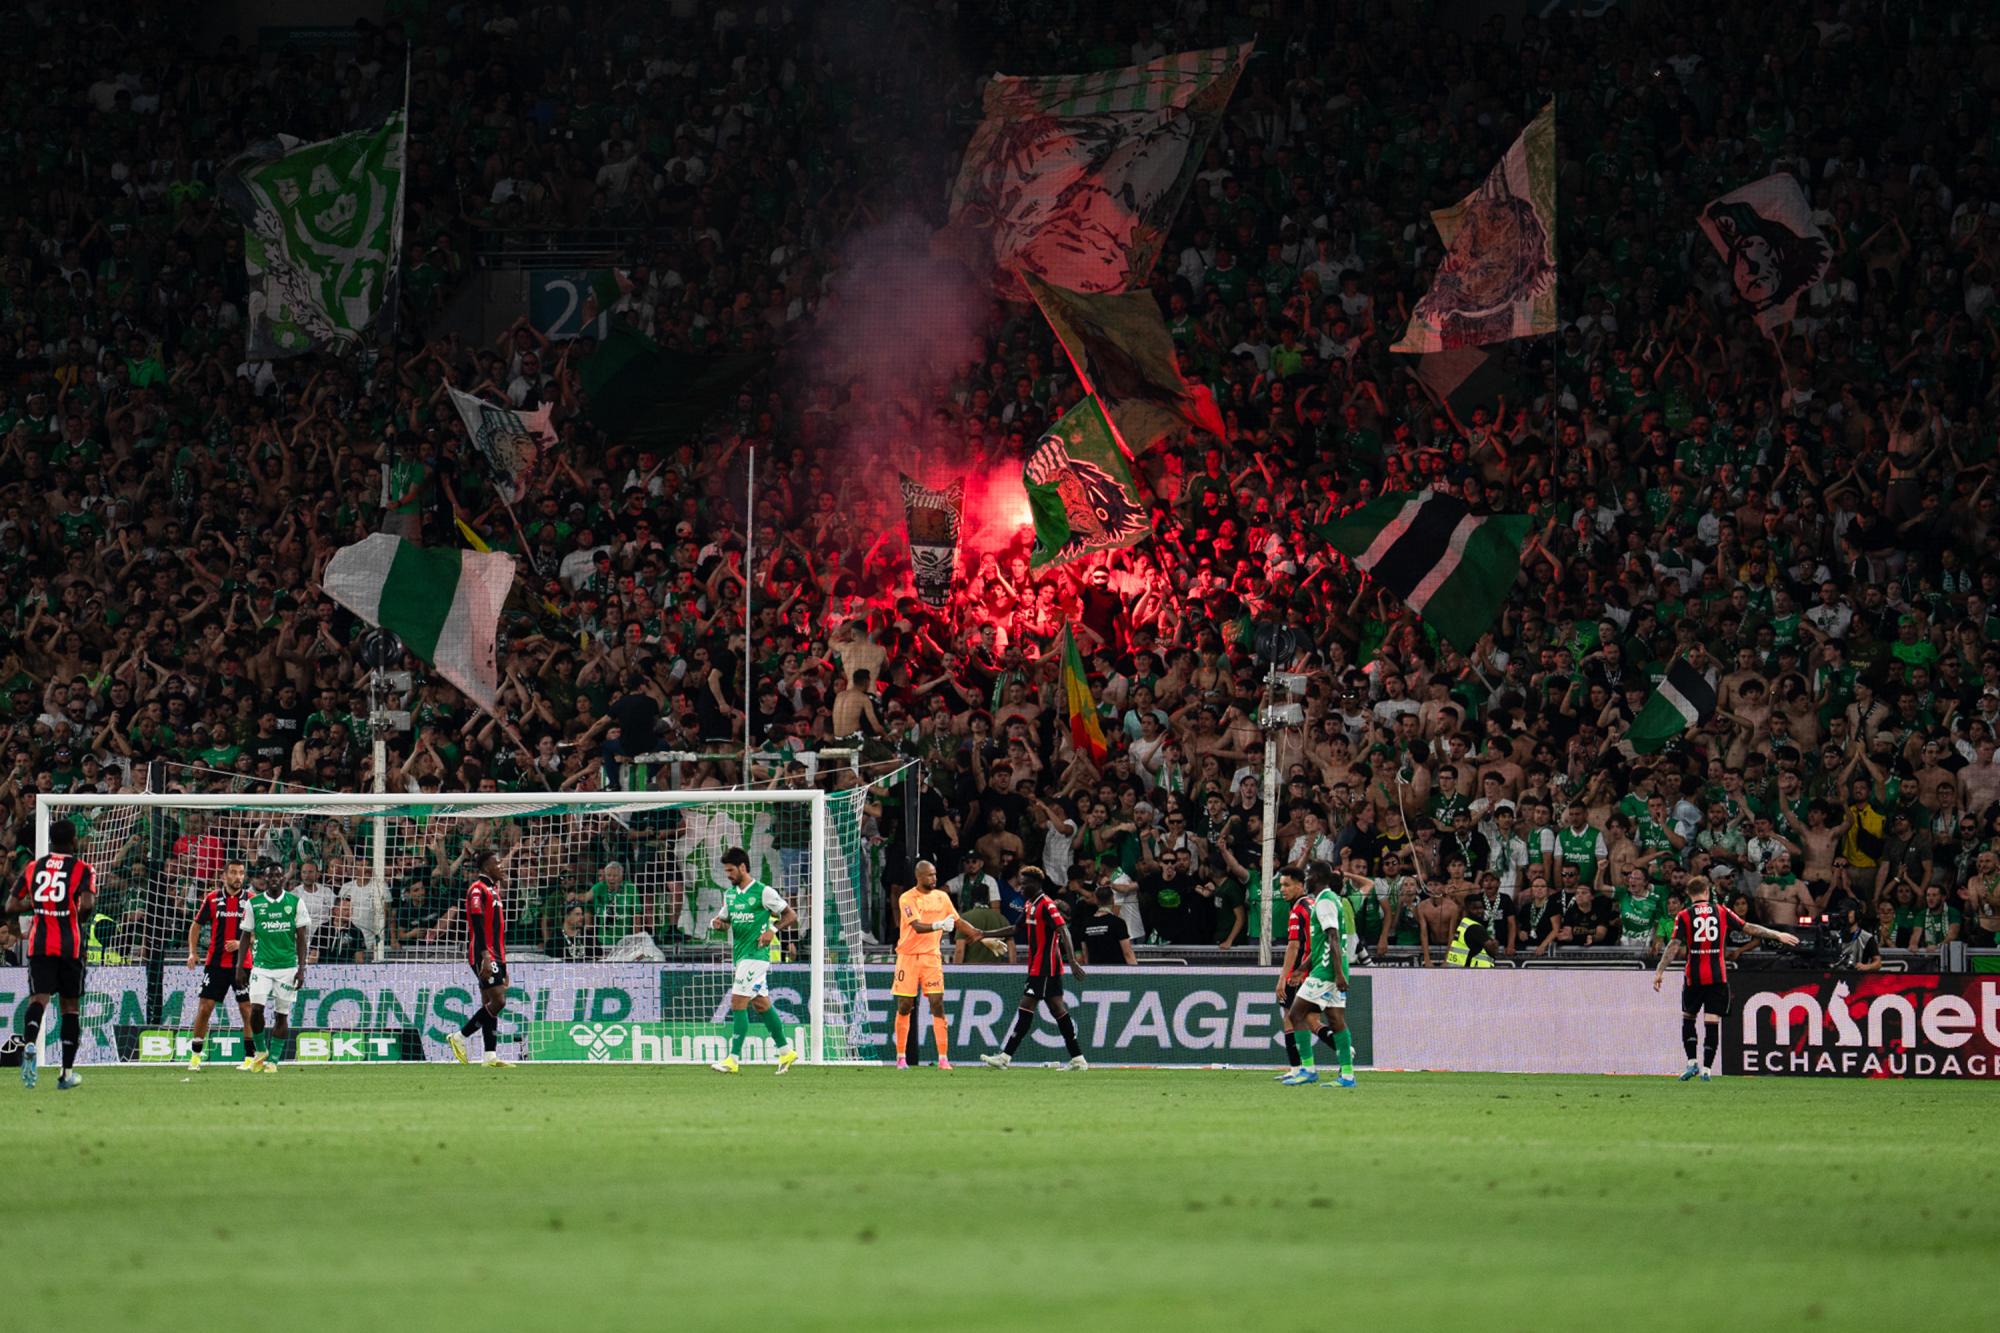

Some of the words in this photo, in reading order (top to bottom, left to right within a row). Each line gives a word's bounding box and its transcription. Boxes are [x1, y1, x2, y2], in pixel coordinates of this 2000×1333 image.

[34, 870, 67, 902] 25
[1693, 916, 1719, 942] 26
[142, 1036, 241, 1057] BKT
[299, 1036, 397, 1057] BKT
